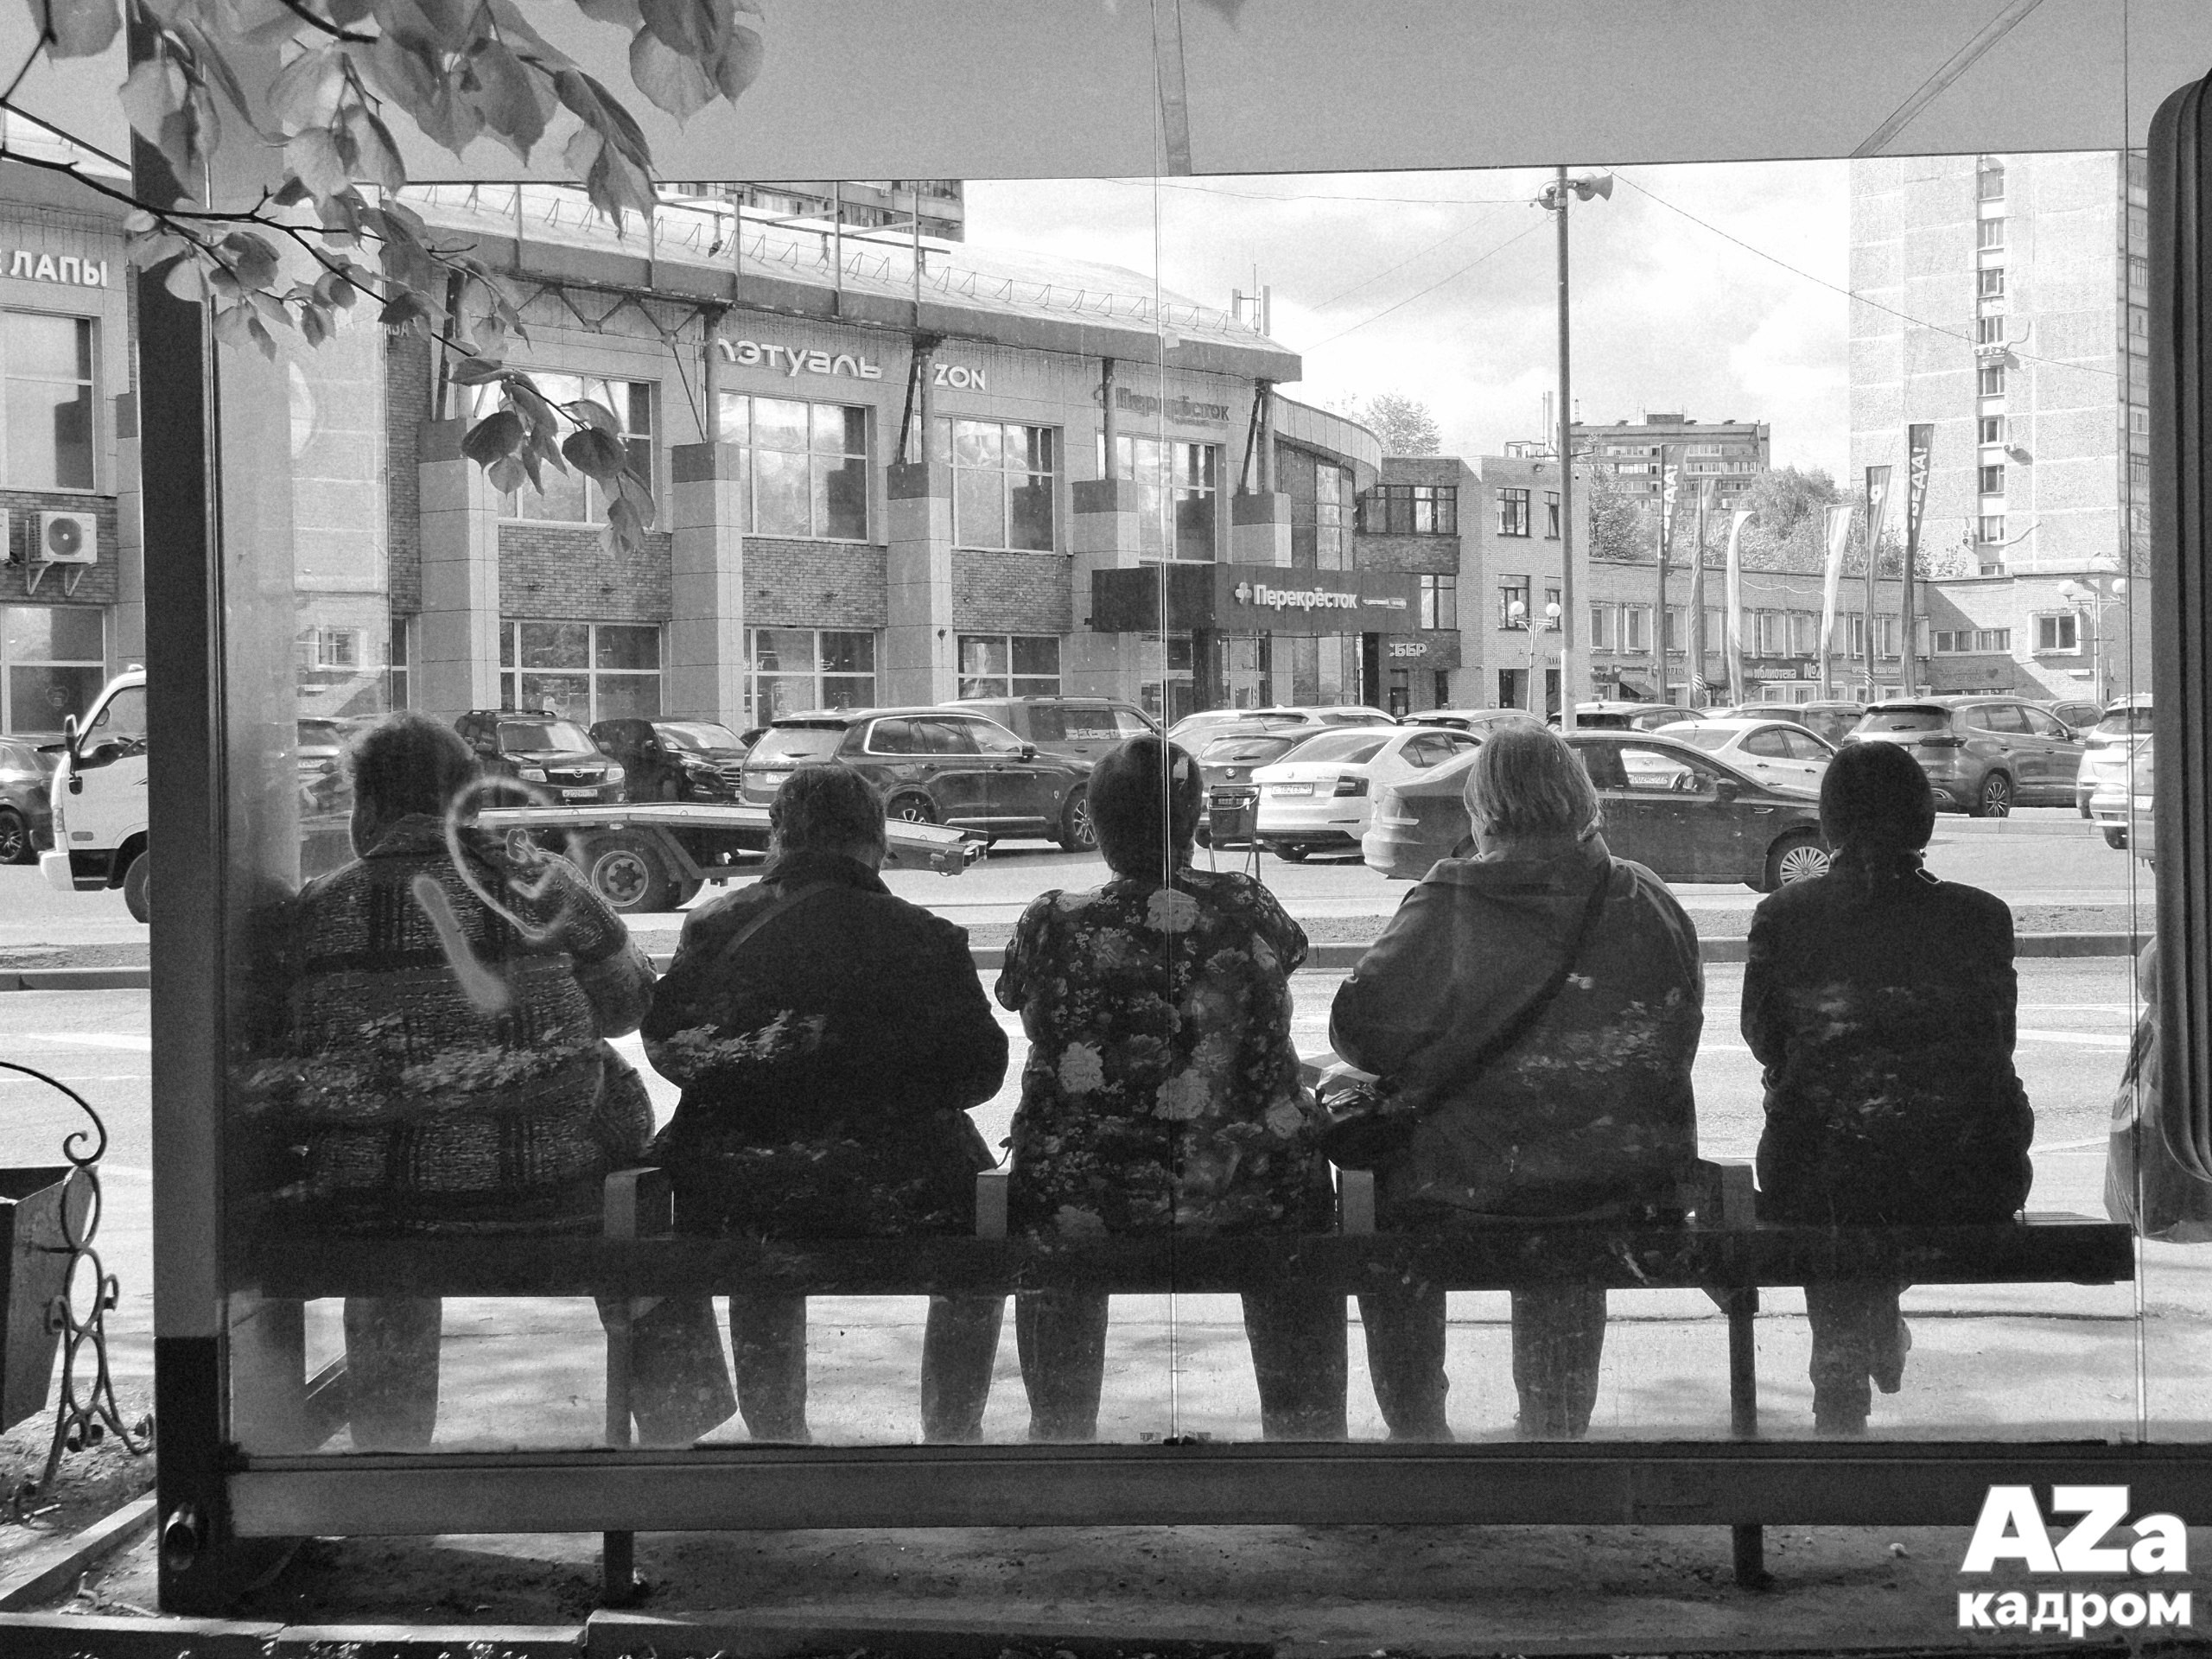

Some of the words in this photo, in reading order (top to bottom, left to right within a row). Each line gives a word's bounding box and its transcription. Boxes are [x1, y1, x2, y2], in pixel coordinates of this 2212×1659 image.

[10, 250, 108, 287] ЛАПЫ
[917, 363, 987, 391] ZON
[1254, 583, 1357, 612] Перекрёсток
[1753, 664, 1797, 679] иблиотека
